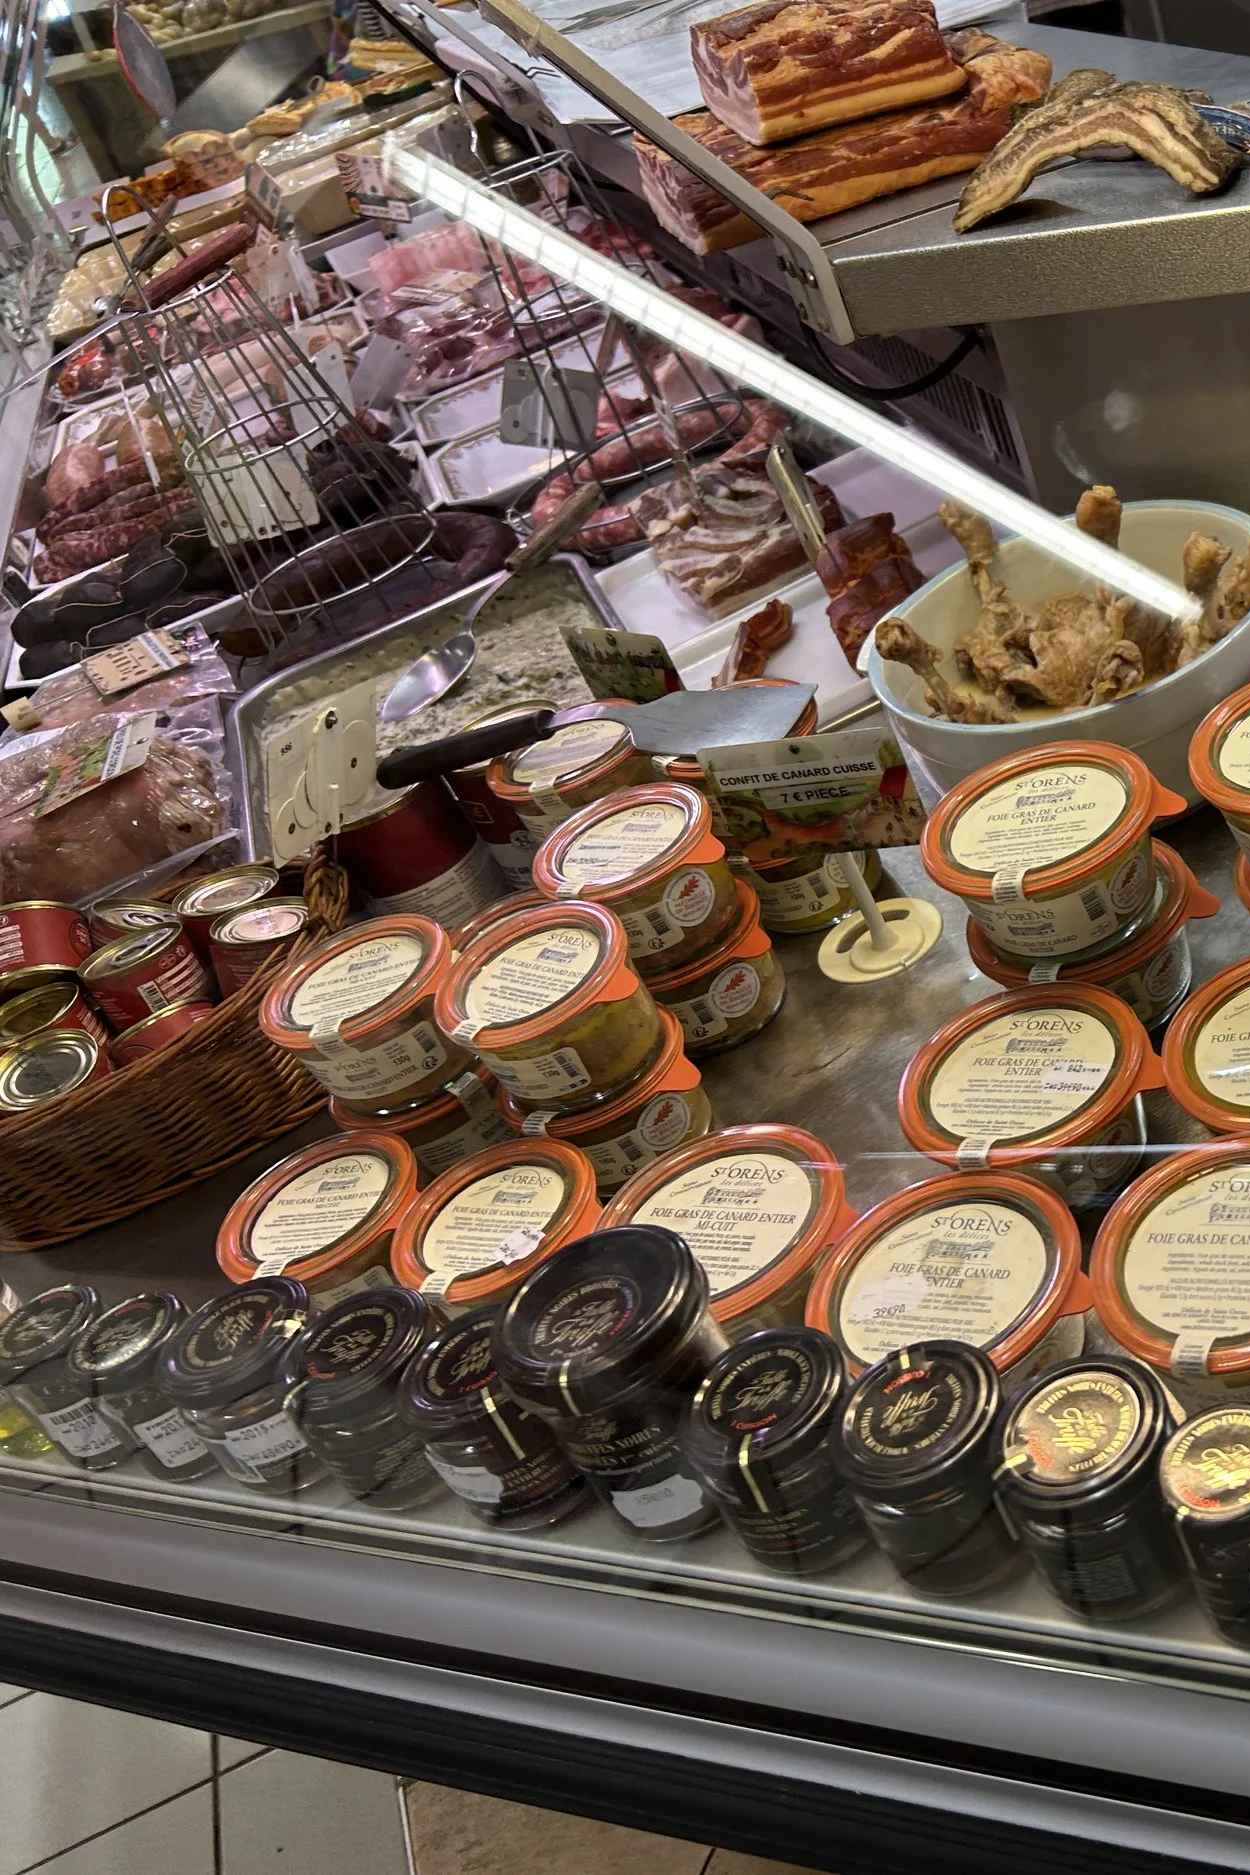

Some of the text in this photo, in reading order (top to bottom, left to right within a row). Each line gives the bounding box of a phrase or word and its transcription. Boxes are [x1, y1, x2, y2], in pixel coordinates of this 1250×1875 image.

[720, 761, 876, 787] CONFIT DE CANARD CUISSE
[780, 792, 788, 804] 7
[803, 786, 849, 801] PIECE
[987, 802, 1096, 822] FOIE GRAS DE CANARD
[1020, 815, 1057, 825] ENTIER
[1210, 1033, 1236, 1044] FOIE
[972, 1058, 998, 1067] FOIE
[998, 1058, 1023, 1067] GRAS
[1025, 1058, 1039, 1066] DE
[1003, 1067, 1042, 1076] ENTIER
[650, 1208, 797, 1224] FOIE GRAS DE CANARD ENTIER
[696, 1221, 738, 1232] MI-CUIT
[1148, 1233, 1175, 1244] FOIE
[1177, 1234, 1208, 1244] GRAS
[1210, 1235, 1228, 1245] DE
[889, 1262, 916, 1273] FOIE
[949, 1267, 962, 1276] DE
[964, 1267, 1010, 1279] CANARD
